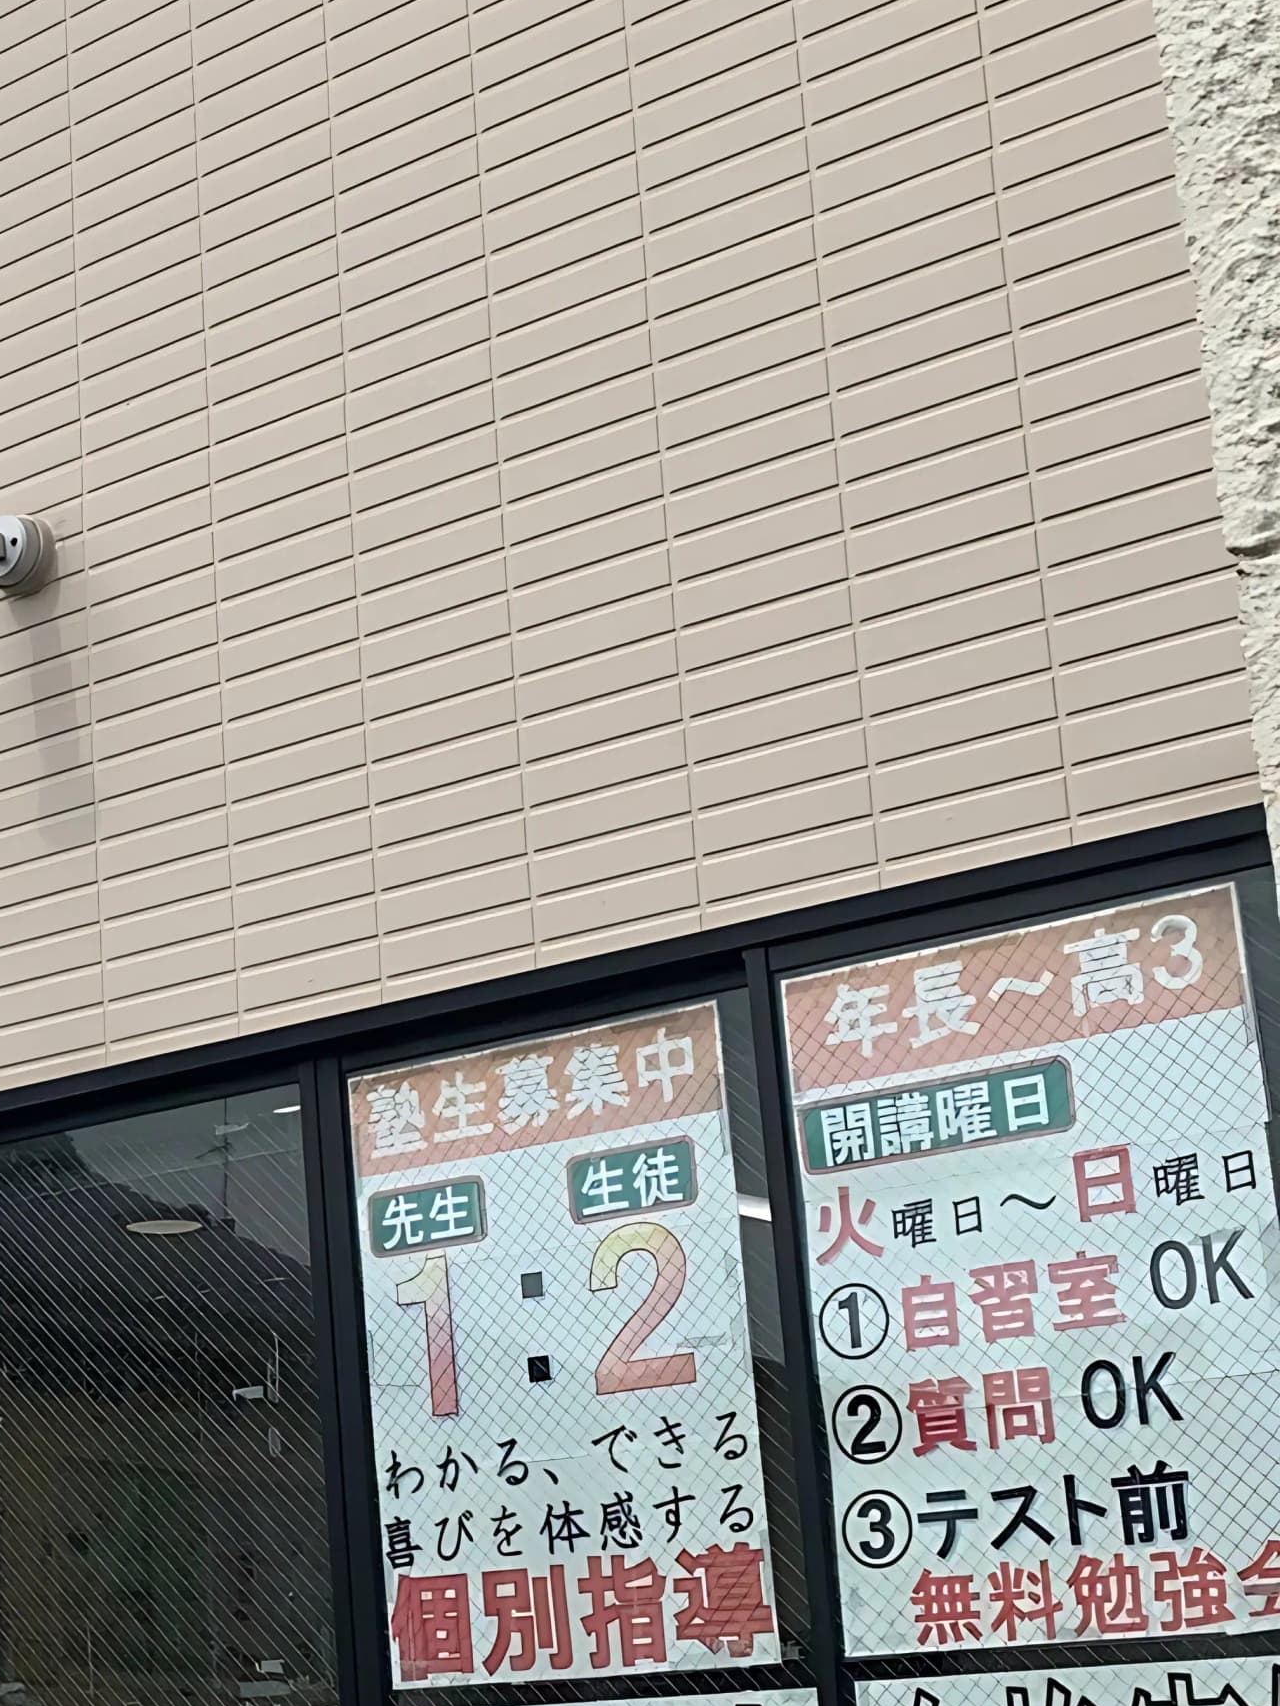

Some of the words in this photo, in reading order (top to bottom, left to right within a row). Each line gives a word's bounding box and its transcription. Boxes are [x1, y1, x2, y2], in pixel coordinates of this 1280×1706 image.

[366, 1027, 694, 1158] 塾生募集中
[820, 1073, 1050, 1167] 開講曜日
[381, 1186, 475, 1250] 先生
[580, 1148, 683, 1215] 生徒
[1149, 1227, 1255, 1310] OK
[1081, 1352, 1184, 1429] OK
[386, 1411, 749, 1499] わかる、できる
[385, 1484, 754, 1569] 喜びを体感する
[391, 1542, 774, 1682] 個別指導
